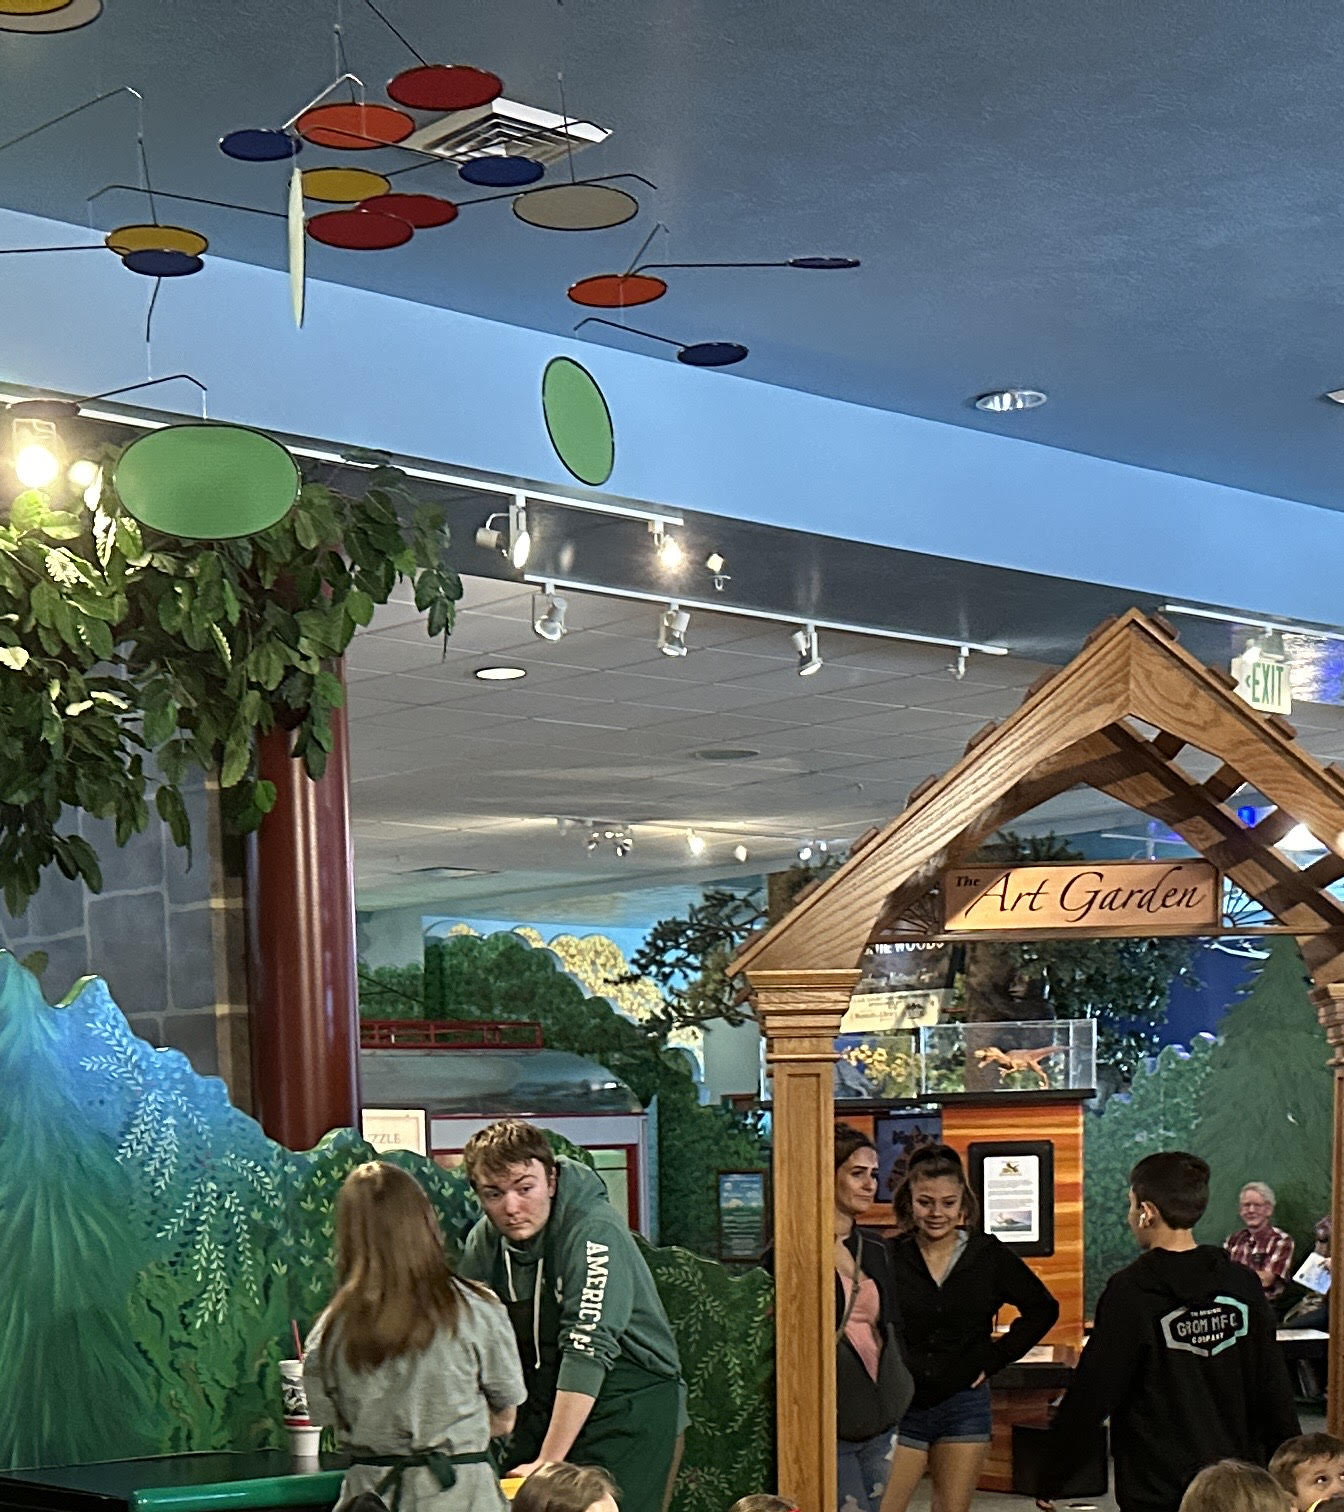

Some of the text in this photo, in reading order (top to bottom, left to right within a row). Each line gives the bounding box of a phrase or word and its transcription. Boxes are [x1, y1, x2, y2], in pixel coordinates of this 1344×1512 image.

[1252, 662, 1284, 706] EXIT
[956, 866, 1208, 923] The Art Garden
